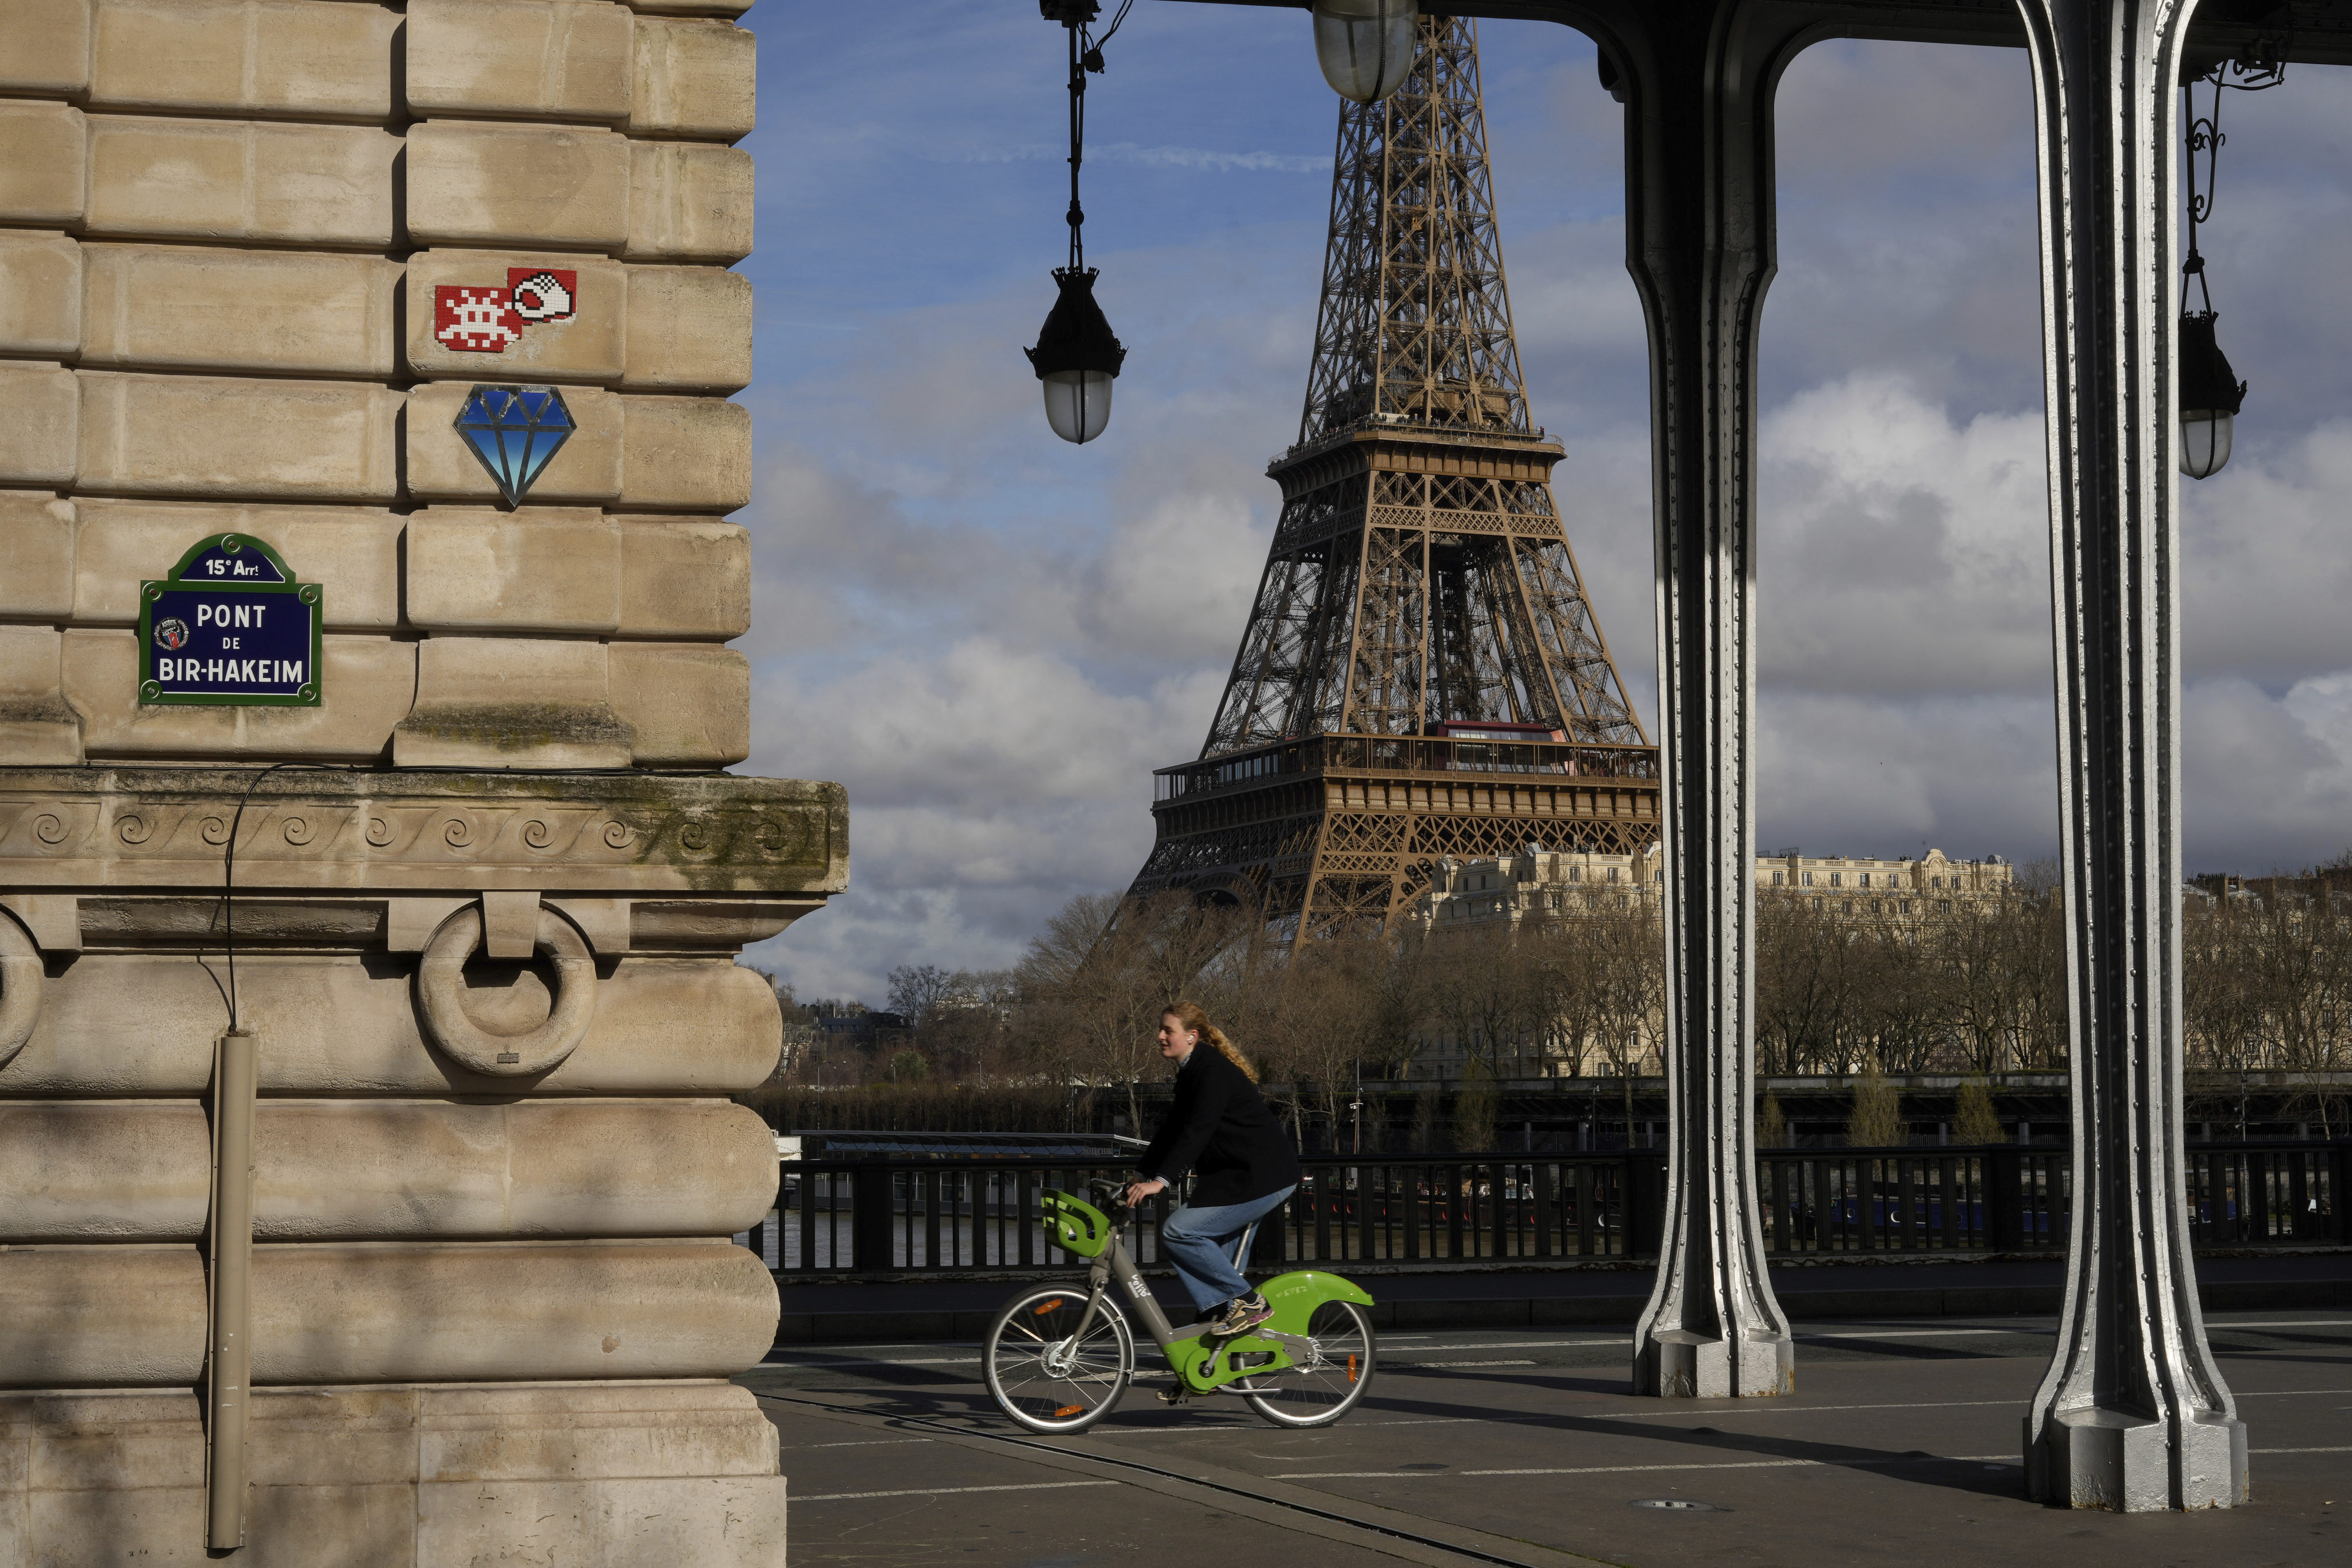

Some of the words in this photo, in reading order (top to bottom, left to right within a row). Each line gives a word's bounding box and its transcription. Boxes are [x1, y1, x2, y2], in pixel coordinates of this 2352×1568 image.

[197, 604, 266, 628] PONT
[222, 637, 240, 650] DE
[160, 658, 302, 683] BIR-HAKEIM
